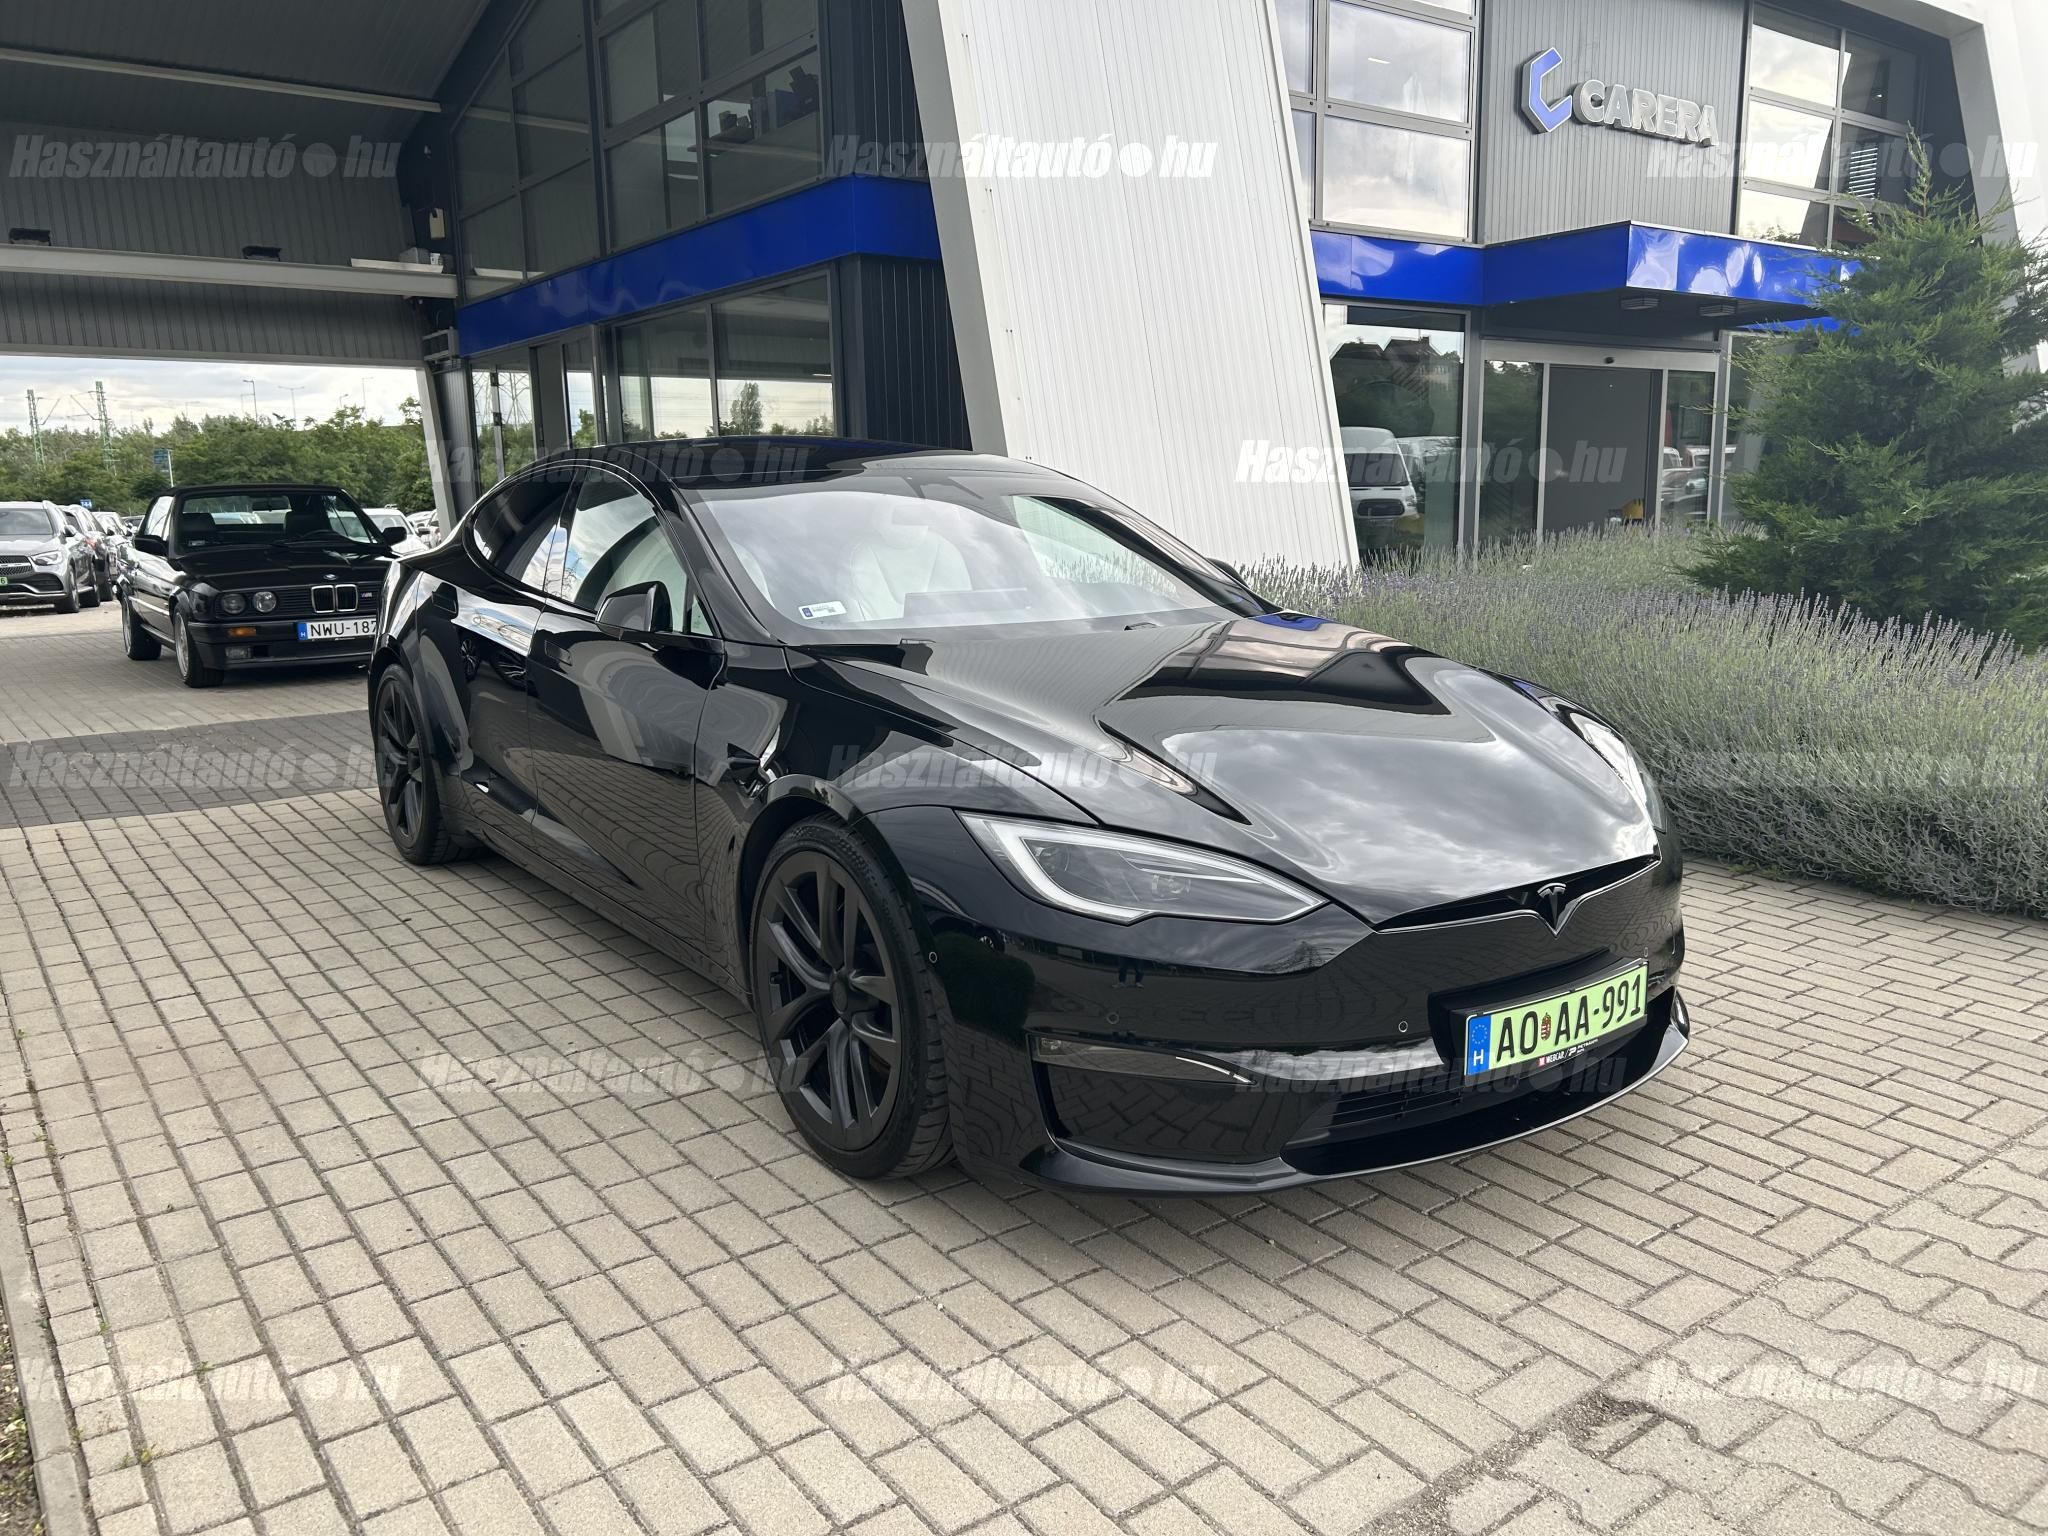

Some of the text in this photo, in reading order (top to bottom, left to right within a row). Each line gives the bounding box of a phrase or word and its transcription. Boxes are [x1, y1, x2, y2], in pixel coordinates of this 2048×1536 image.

[1574, 79, 1720, 146] CARERA
[1496, 1011, 1538, 1062] AO
[1554, 974, 1641, 1046] AA-991
